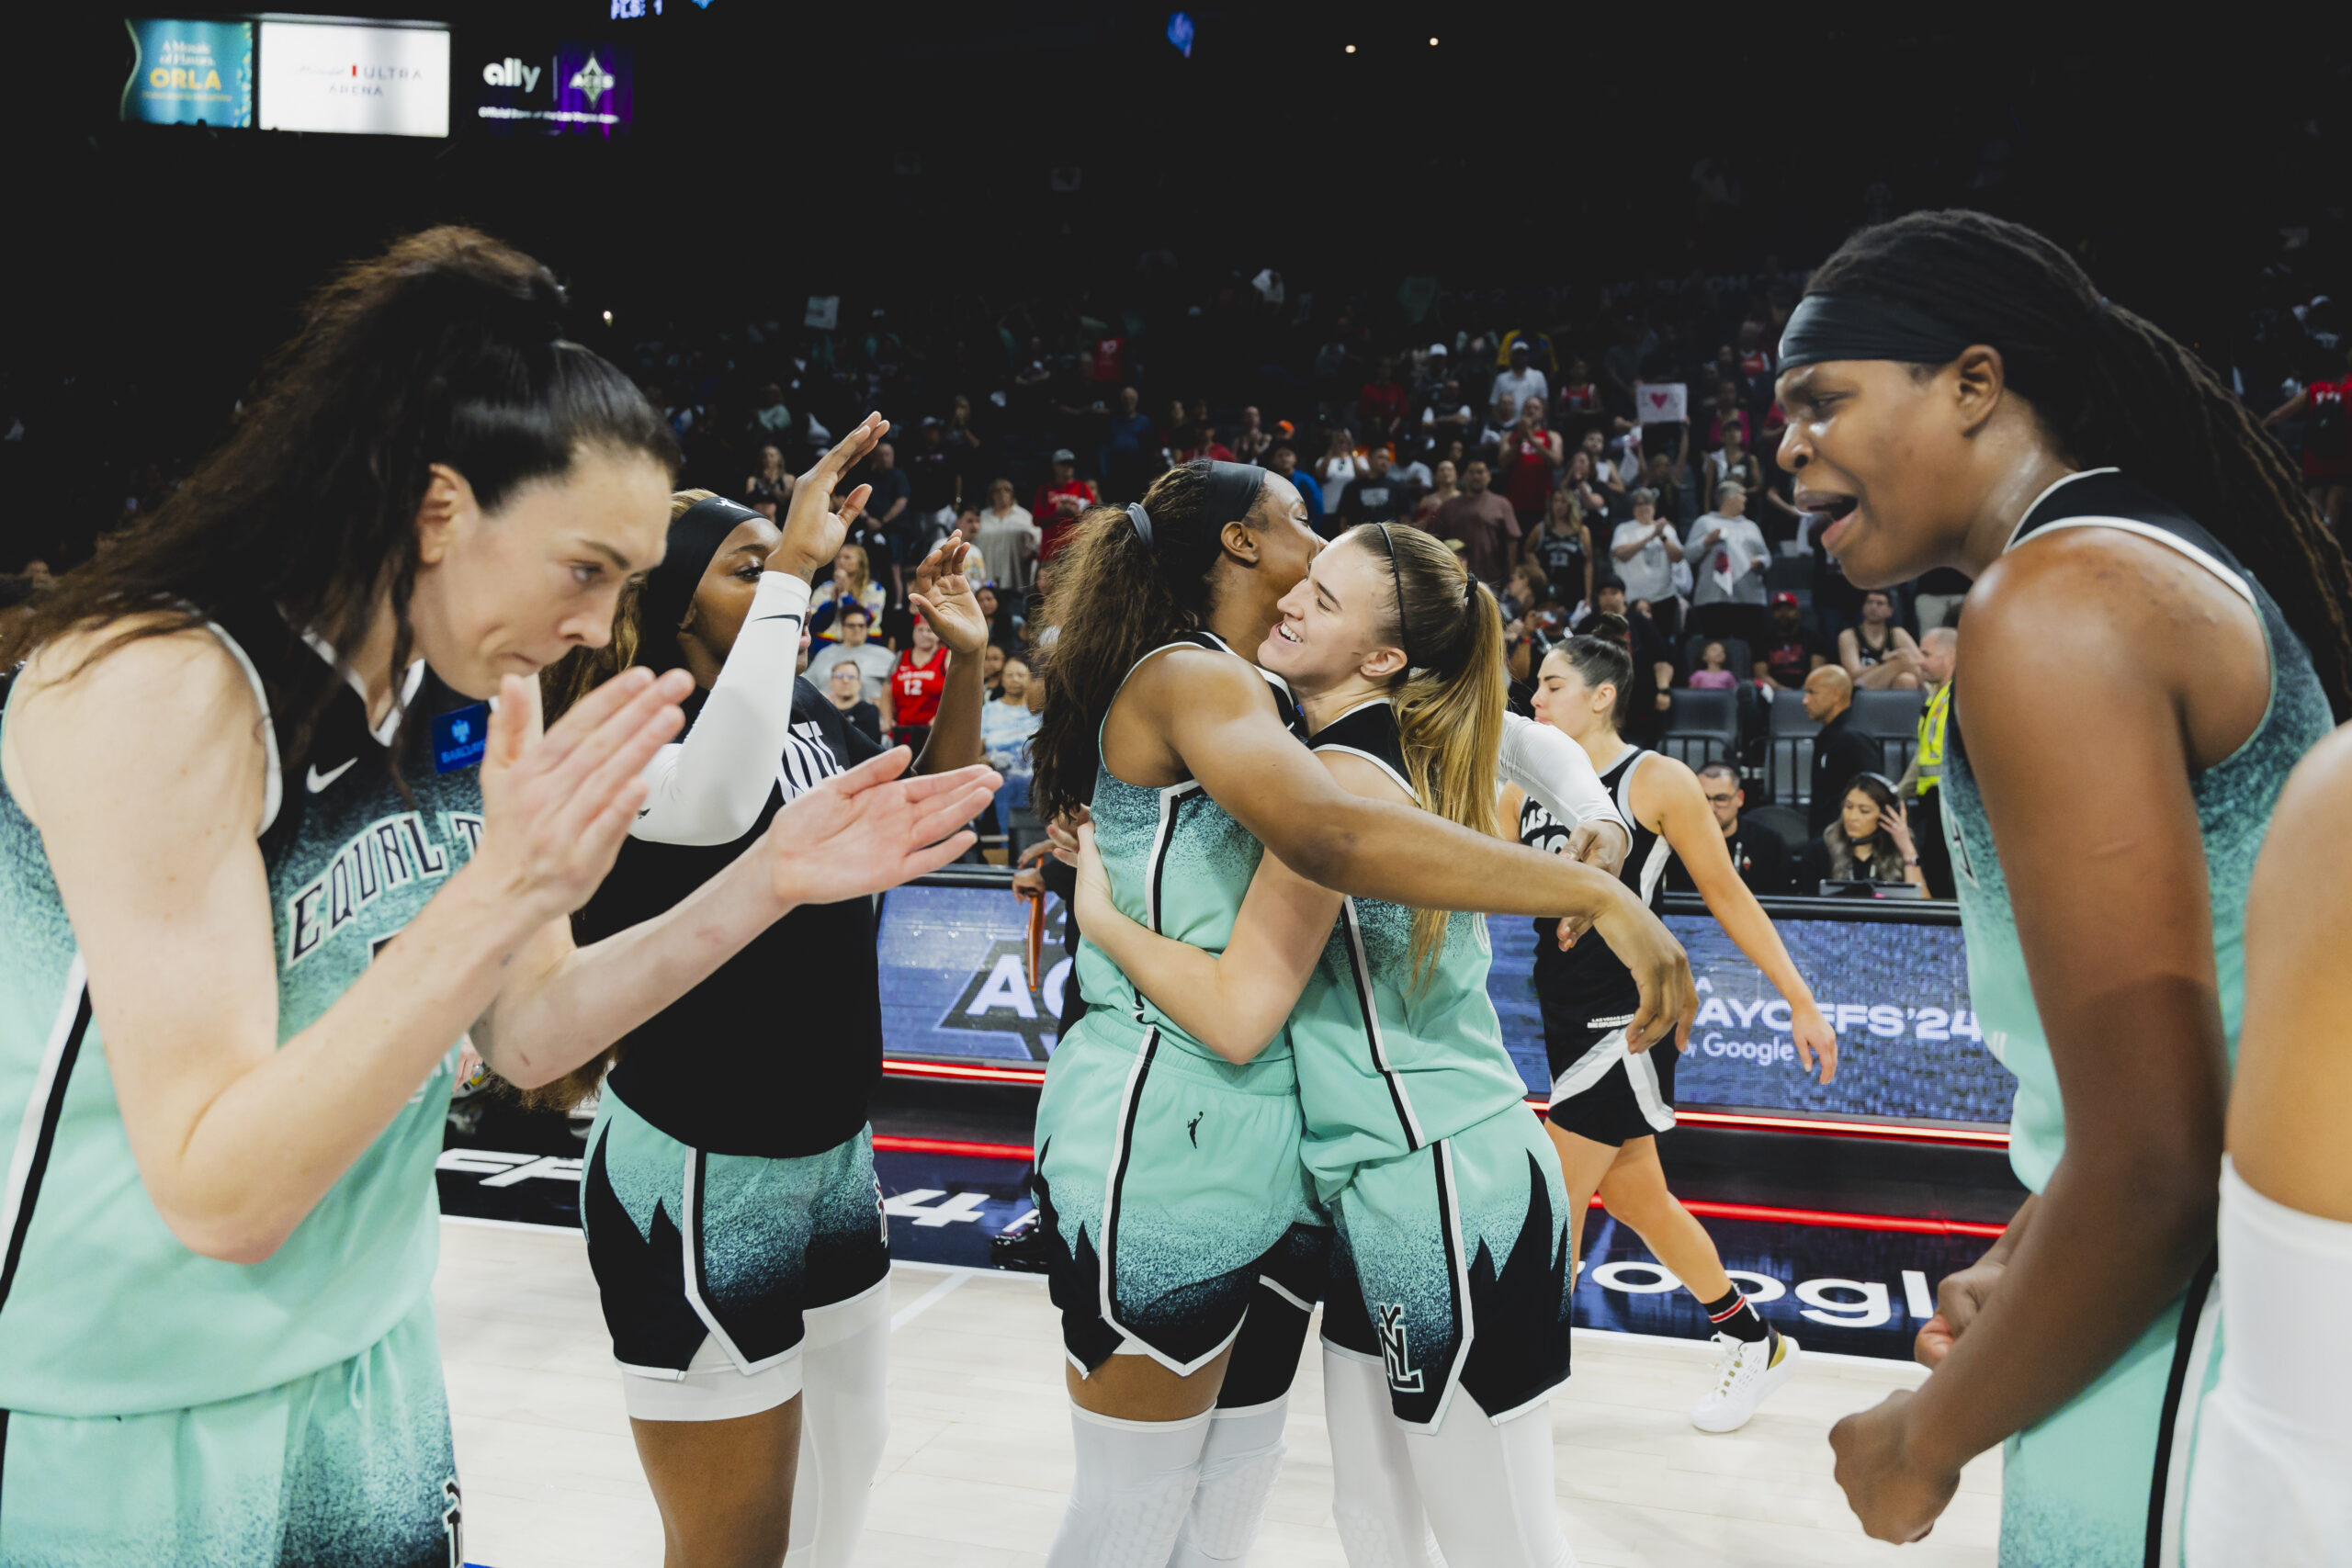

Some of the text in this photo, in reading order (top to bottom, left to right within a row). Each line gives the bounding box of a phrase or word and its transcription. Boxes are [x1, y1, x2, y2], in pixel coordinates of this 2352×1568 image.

[150, 67, 221, 90] ORLA
[364, 66, 423, 80] ULTRA
[482, 57, 541, 93] ally
[904, 679, 922, 695] 12
[287, 809, 487, 969] EQUALT
[1702, 1032, 1794, 1066] Google
